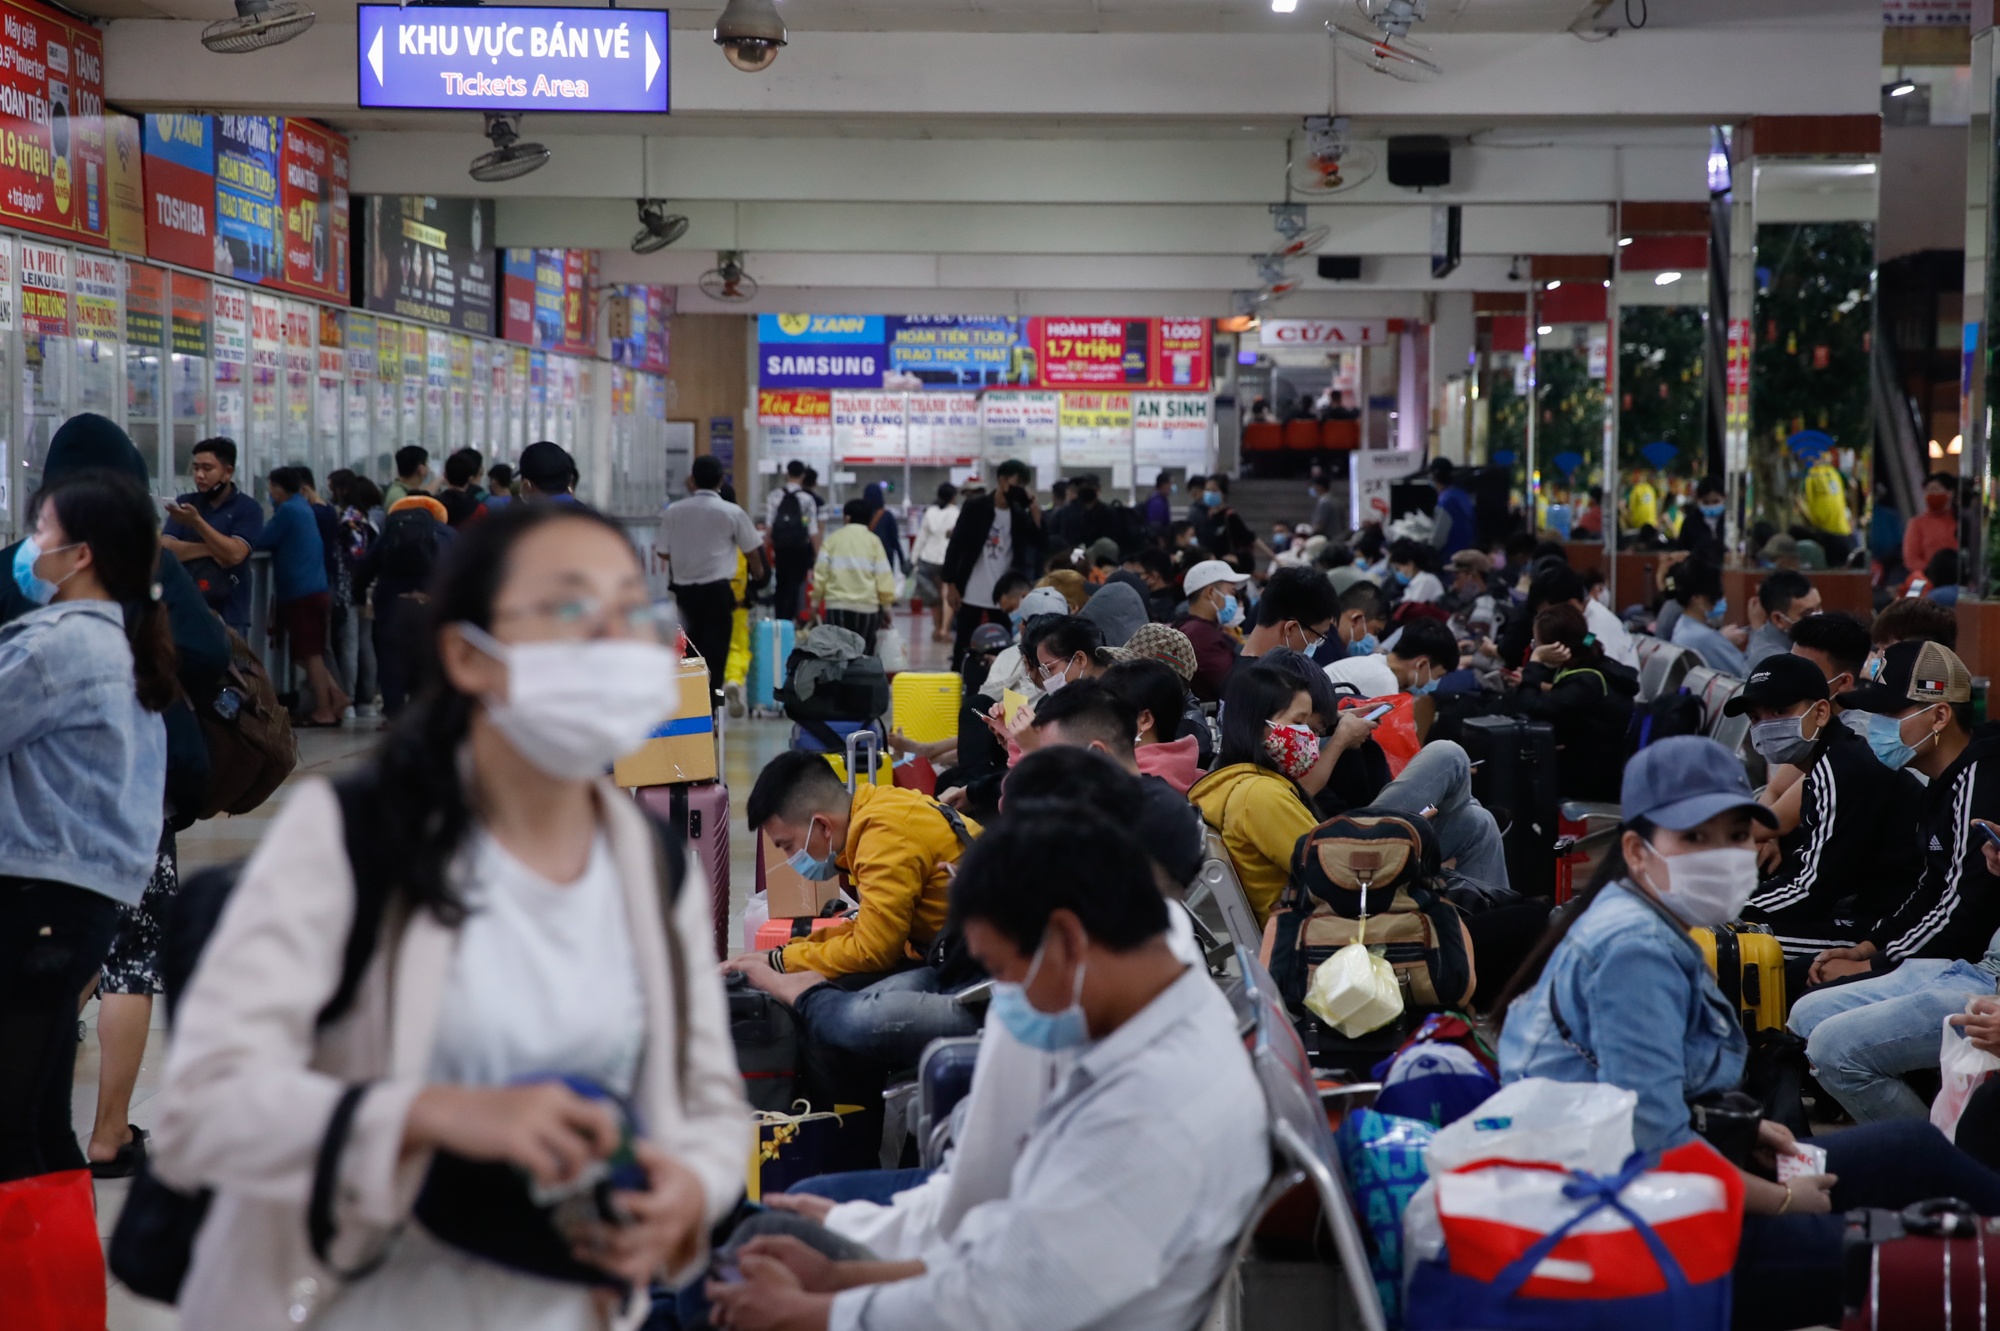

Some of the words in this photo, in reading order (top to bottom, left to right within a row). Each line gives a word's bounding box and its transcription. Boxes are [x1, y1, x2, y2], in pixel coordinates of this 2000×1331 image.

[5, 14, 20, 46] Máy
[399, 25, 458, 55] KHU
[464, 22, 524, 64] VỰC
[531, 21, 588, 58] BÁN
[595, 23, 630, 59] VÉ
[74, 42, 100, 86] TẶNG
[441, 72, 527, 97] Tickets
[532, 74, 589, 98] Area
[26, 88, 49, 127] TIỀN
[18, 135, 49, 183] triệu
[156, 192, 206, 236] TOSHIBA
[75, 253, 92, 280] UÂN
[22, 271, 51, 288] LEIKU
[77, 327, 91, 338] UY
[811, 317, 866, 334] XANH
[1047, 321, 1088, 337] HOÀN
[1089, 319, 1122, 337] TIỀN
[1275, 321, 1347, 341] CỬA
[1361, 327, 1370, 341] I
[895, 348, 932, 362] TRAO
[1046, 339, 1073, 357] 1.7
[1074, 338, 1122, 361] triệu
[767, 356, 876, 376] SAMSUNG
[1138, 401, 1160, 418] AN
[1166, 401, 1207, 418] SINH
